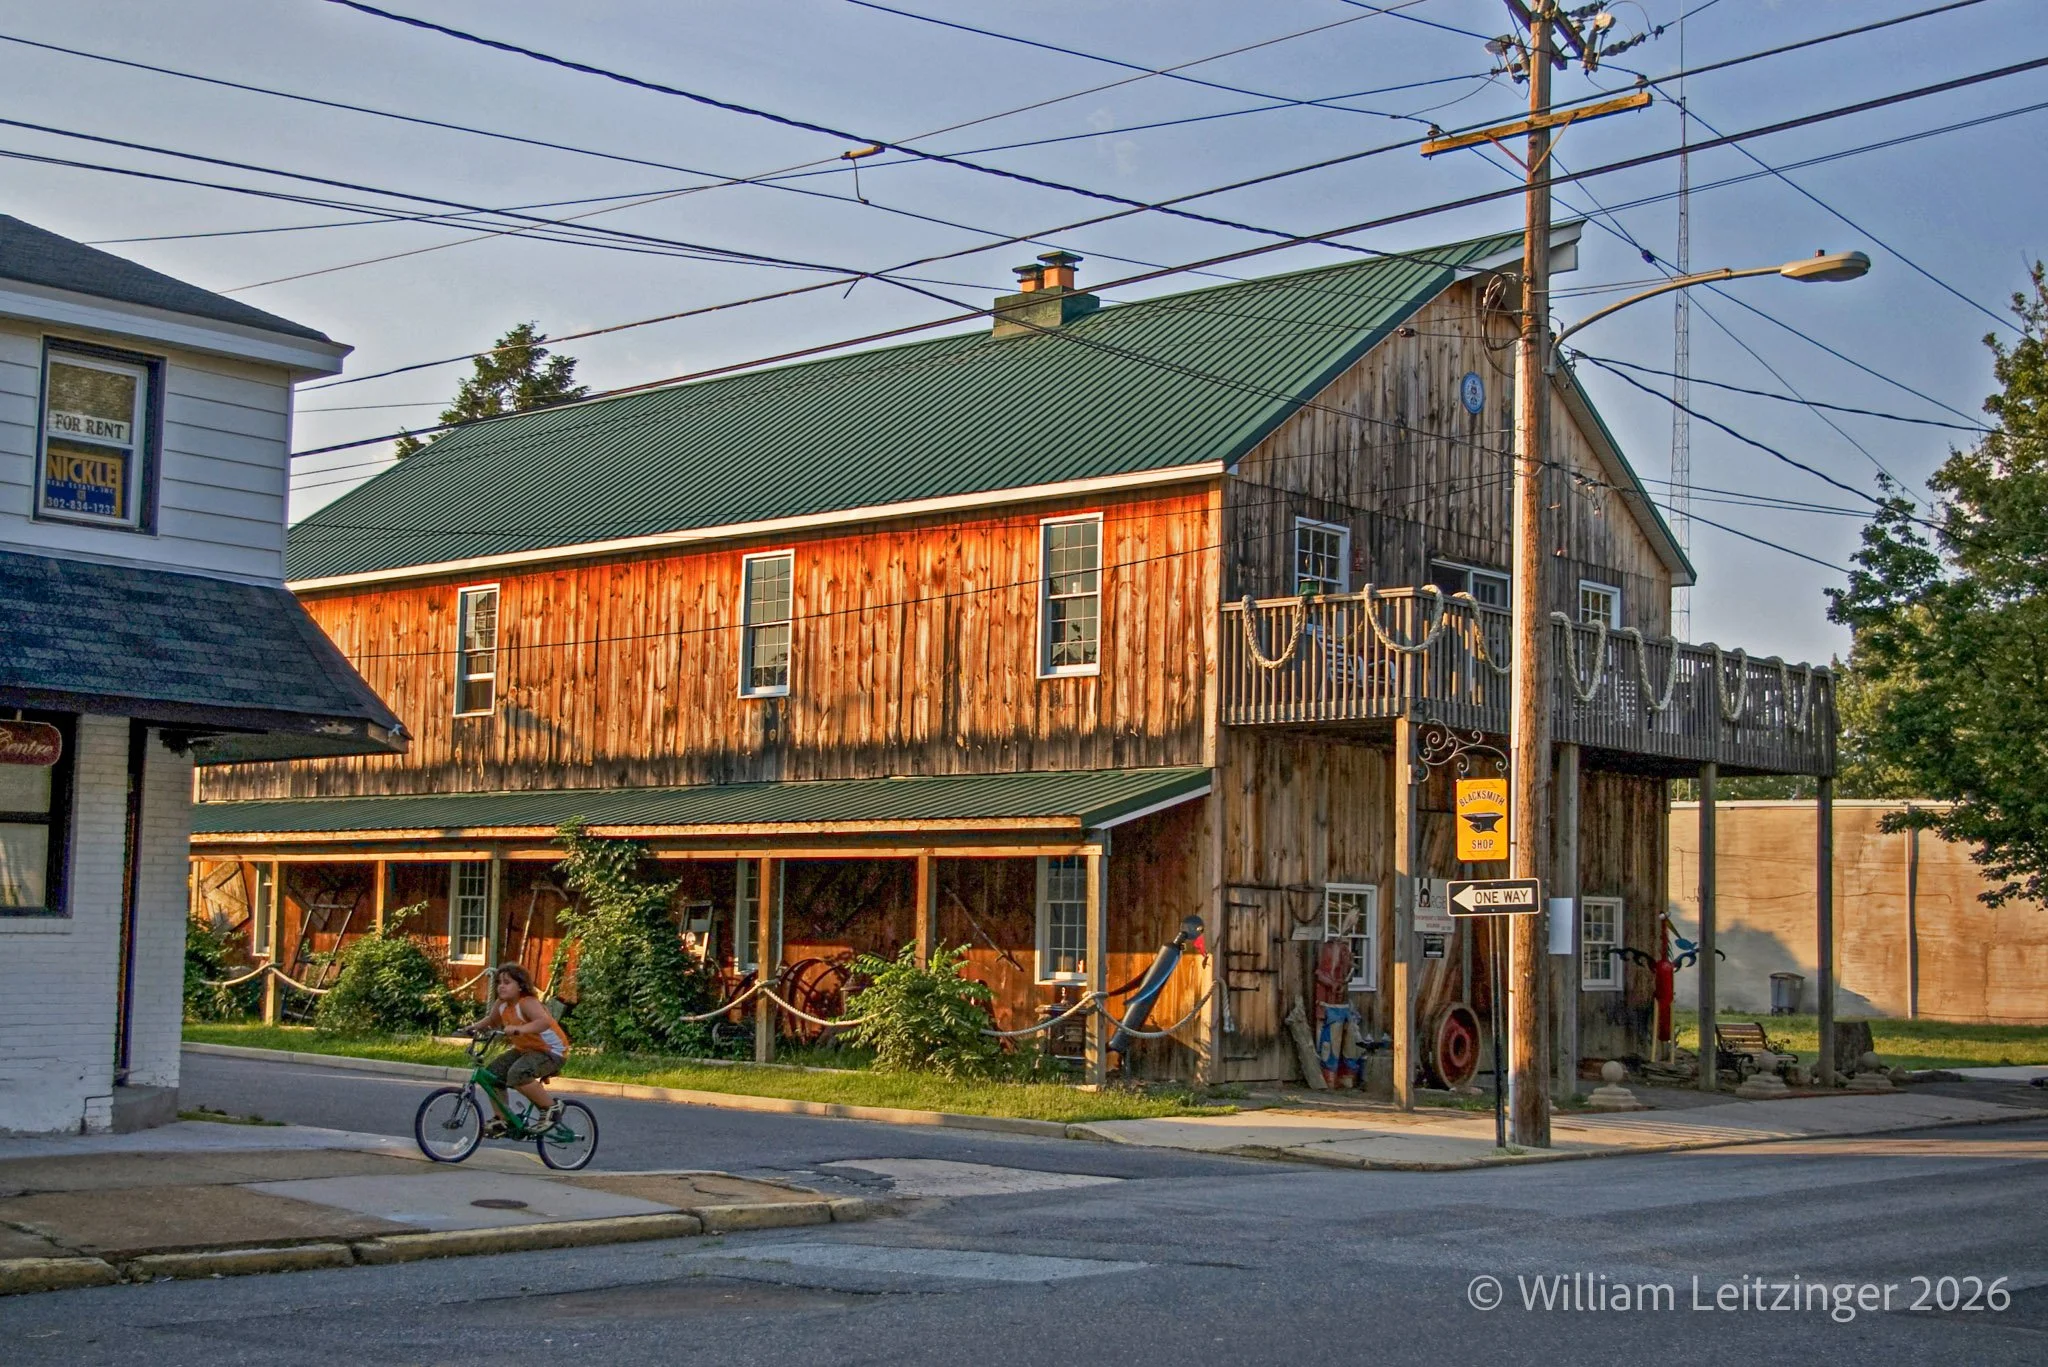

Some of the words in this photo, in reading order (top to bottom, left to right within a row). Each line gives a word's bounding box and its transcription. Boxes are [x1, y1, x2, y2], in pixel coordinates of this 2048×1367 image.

[55, 413, 81, 432] FOR
[86, 418, 125, 439] RENT
[47, 455, 117, 488] NICKLE
[1459, 790, 1505, 807] BLACKSMITH
[1471, 839, 1494, 849] SHOP
[1474, 891, 1499, 904] ONE
[1503, 890, 1528, 903] WAY
